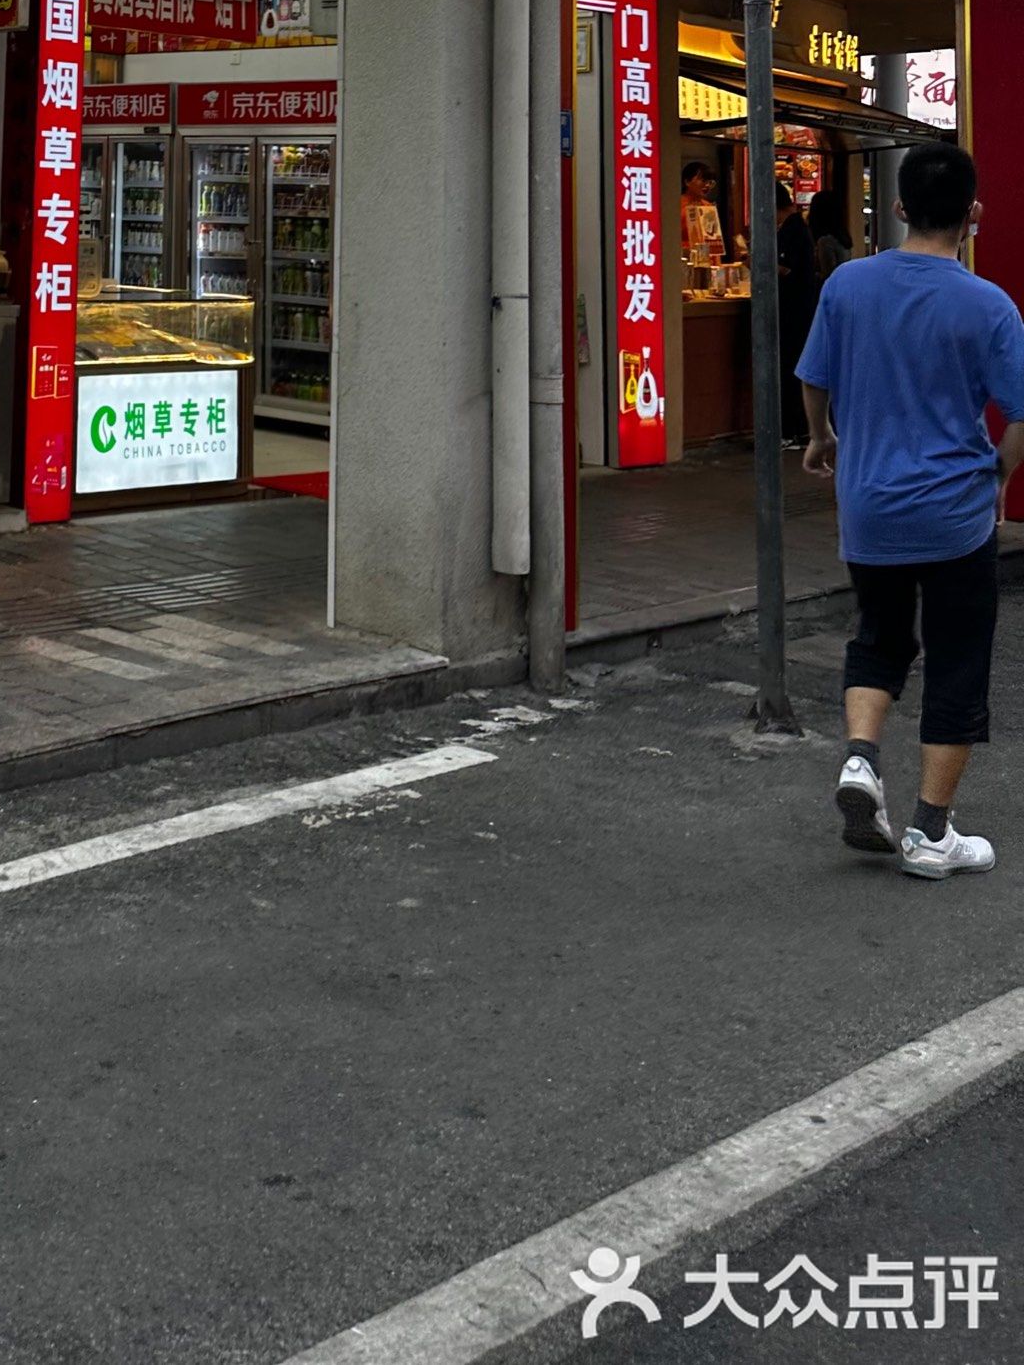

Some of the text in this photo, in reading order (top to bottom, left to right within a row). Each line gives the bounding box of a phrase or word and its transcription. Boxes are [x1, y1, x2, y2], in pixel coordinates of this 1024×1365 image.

[124, 397, 227, 440] 烟草专柜
[124, 440, 227, 460] CHINA TOBACCO
